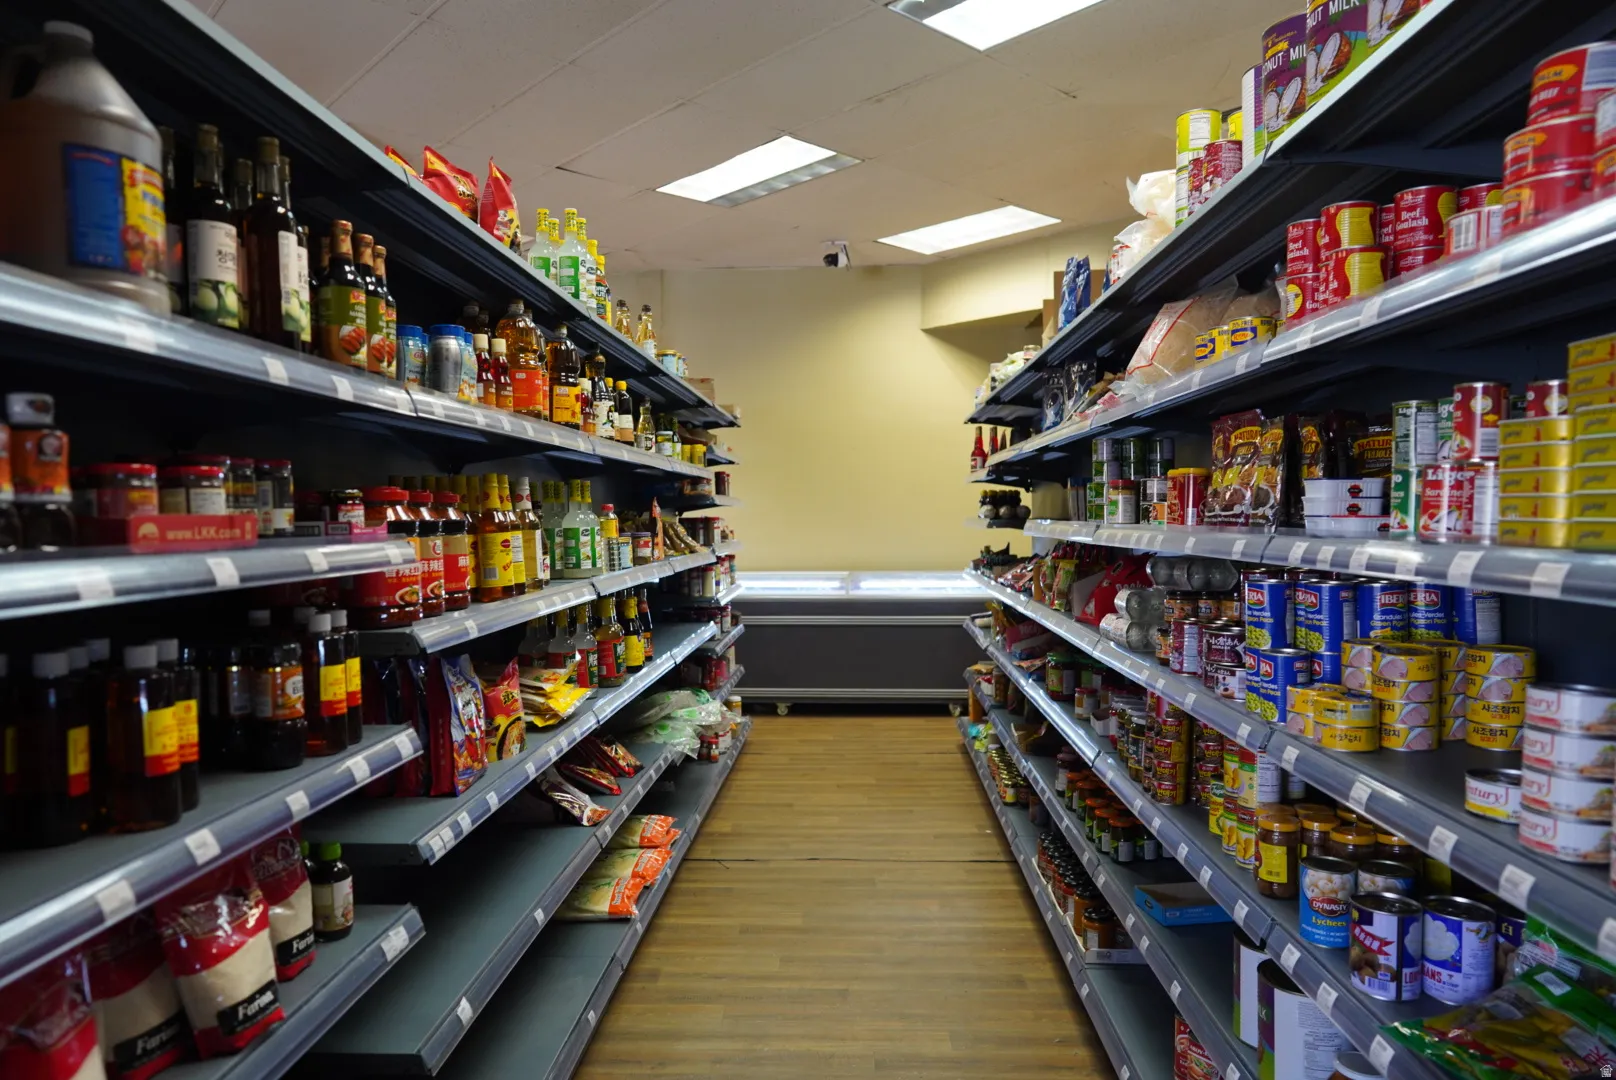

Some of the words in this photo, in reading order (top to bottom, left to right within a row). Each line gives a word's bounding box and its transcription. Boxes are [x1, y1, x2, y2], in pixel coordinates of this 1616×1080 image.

[1401, 208, 1421, 220] Beef
[166, 526, 241, 540] www.LKK.com
[1313, 900, 1347, 911] DYNASTY
[1312, 916, 1346, 926] Lychees
